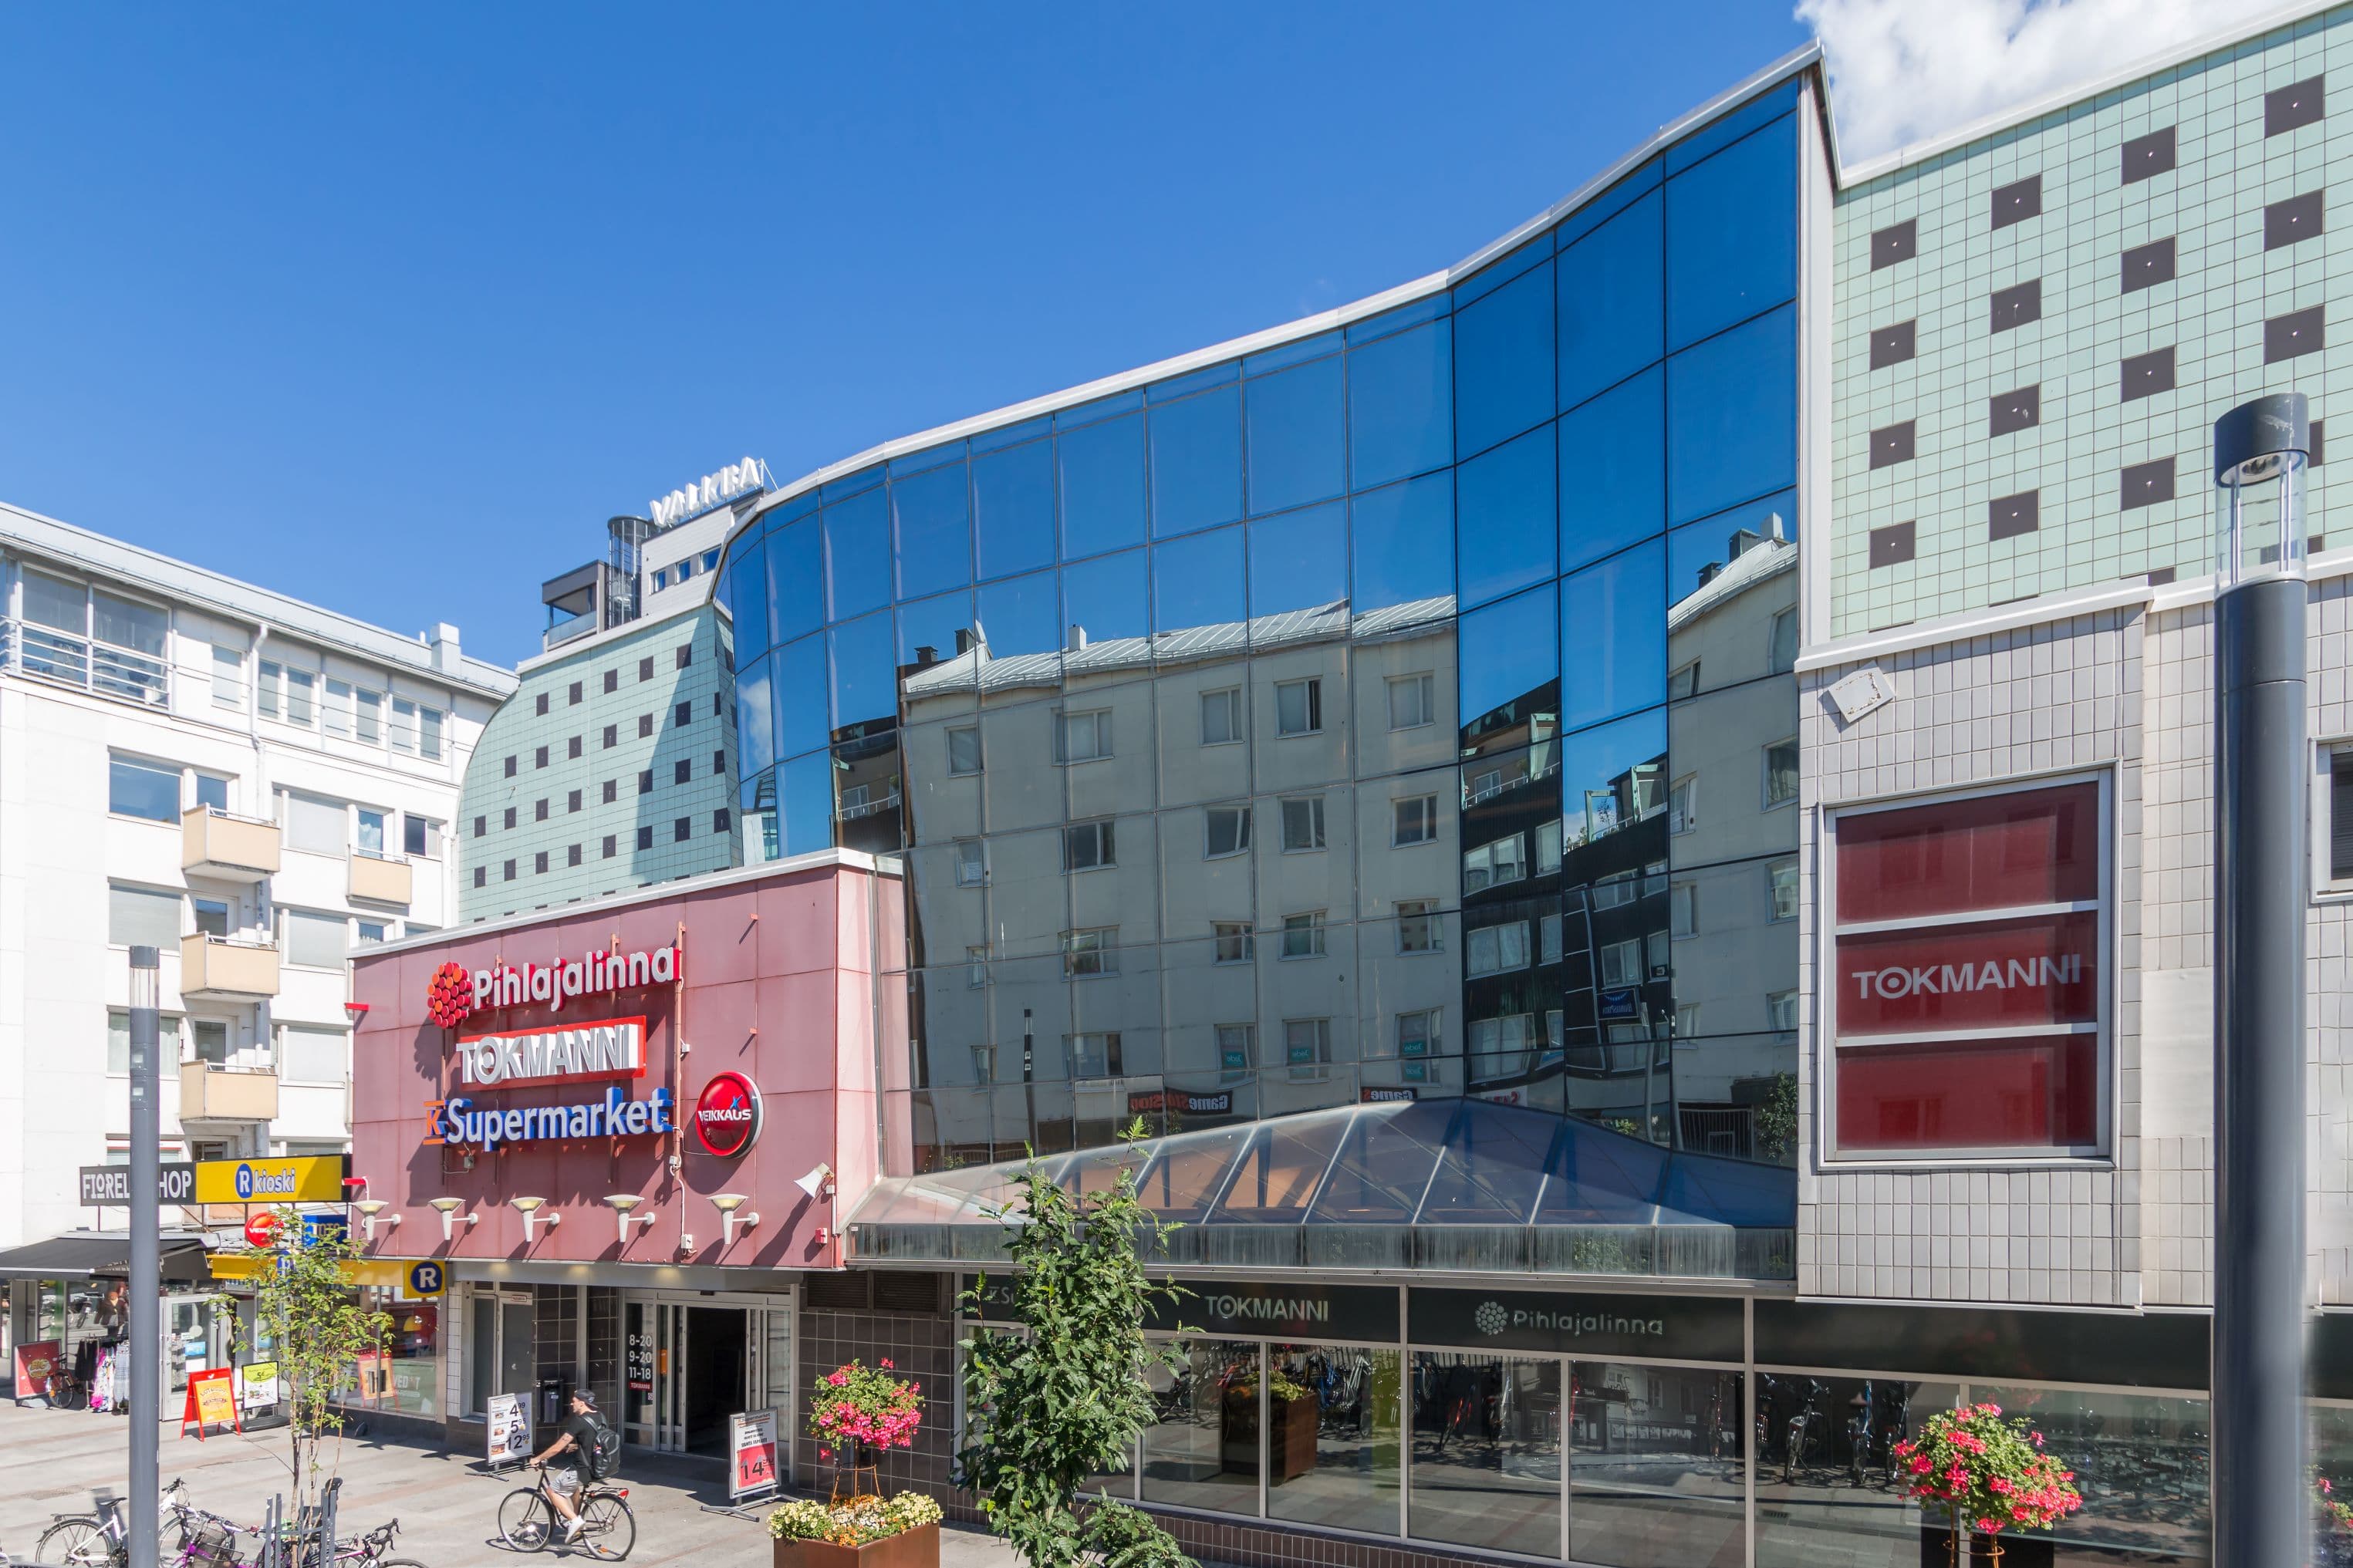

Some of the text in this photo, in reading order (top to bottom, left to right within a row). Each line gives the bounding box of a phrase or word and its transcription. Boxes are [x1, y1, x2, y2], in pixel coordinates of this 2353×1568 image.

[474, 947, 678, 1012] Pihlajalinna
[1852, 953, 2081, 999] TOKMANNI
[456, 1024, 637, 1085] TOKMANNI
[447, 1087, 673, 1152] Supermarket
[697, 1108, 752, 1122] VEIKKAUS
[82, 1170, 192, 1199] FIOREL HOP
[238, 1168, 296, 1194] R kioski
[418, 1267, 437, 1288] R
[1204, 1294, 1329, 1322] TOKMANNI
[1514, 1310, 1664, 1337] Pihlajalinna
[629, 1334, 653, 1347] 8-20
[629, 1350, 653, 1364] 9-20
[629, 1366, 652, 1381] 11-18
